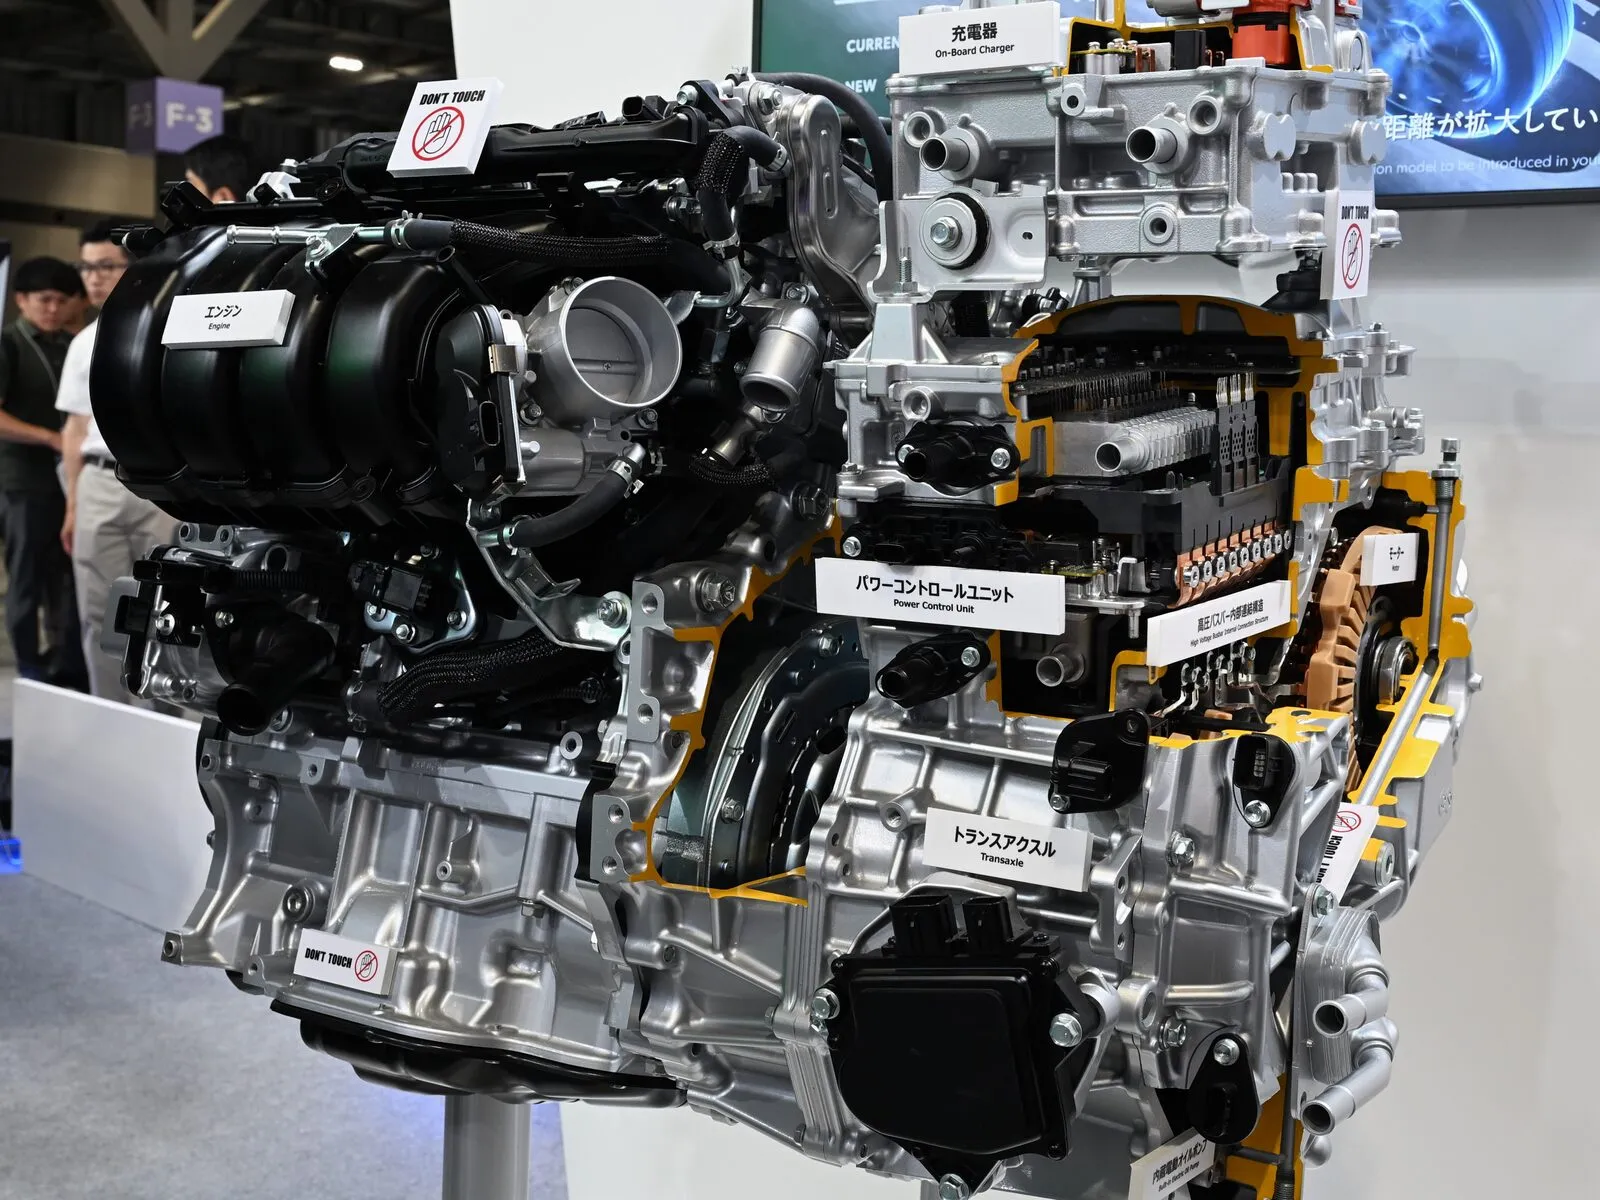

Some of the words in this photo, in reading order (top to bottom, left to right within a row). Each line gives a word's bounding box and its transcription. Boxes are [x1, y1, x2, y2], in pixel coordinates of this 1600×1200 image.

[951, 22, 998, 42] 充電器
[846, 35, 900, 53] CURREN
[935, 46, 977, 58] On-Board
[979, 43, 1015, 56] Charger
[844, 78, 878, 93] NEW
[419, 92, 450, 106] DON'T
[451, 90, 486, 103] TOUCH
[165, 101, 214, 134] F-3
[1383, 107, 1599, 141] 距離が拡大してい
[1396, 161, 1437, 173] model
[1440, 162, 1455, 173] to
[1458, 159, 1476, 171] be
[1479, 155, 1552, 170] introduced
[1556, 156, 1568, 167] in
[1355, 205, 1369, 220] TOUCH
[204, 304, 242, 318] エンジン
[208, 323, 231, 331] Engine
[856, 574, 1014, 603] パワーコントロールユニット
[893, 599, 920, 609] Power
[922, 601, 953, 612] Control
[956, 604, 975, 614] Unit
[1190, 638, 1199, 647] High
[1199, 635, 1212, 644] Voltage
[1224, 626, 1237, 636] Internal
[954, 825, 1056, 858] トランスアクスル
[980, 852, 1024, 868] Transaxle
[304, 947, 326, 963] DON'T
[328, 953, 353, 969] TOUCH
